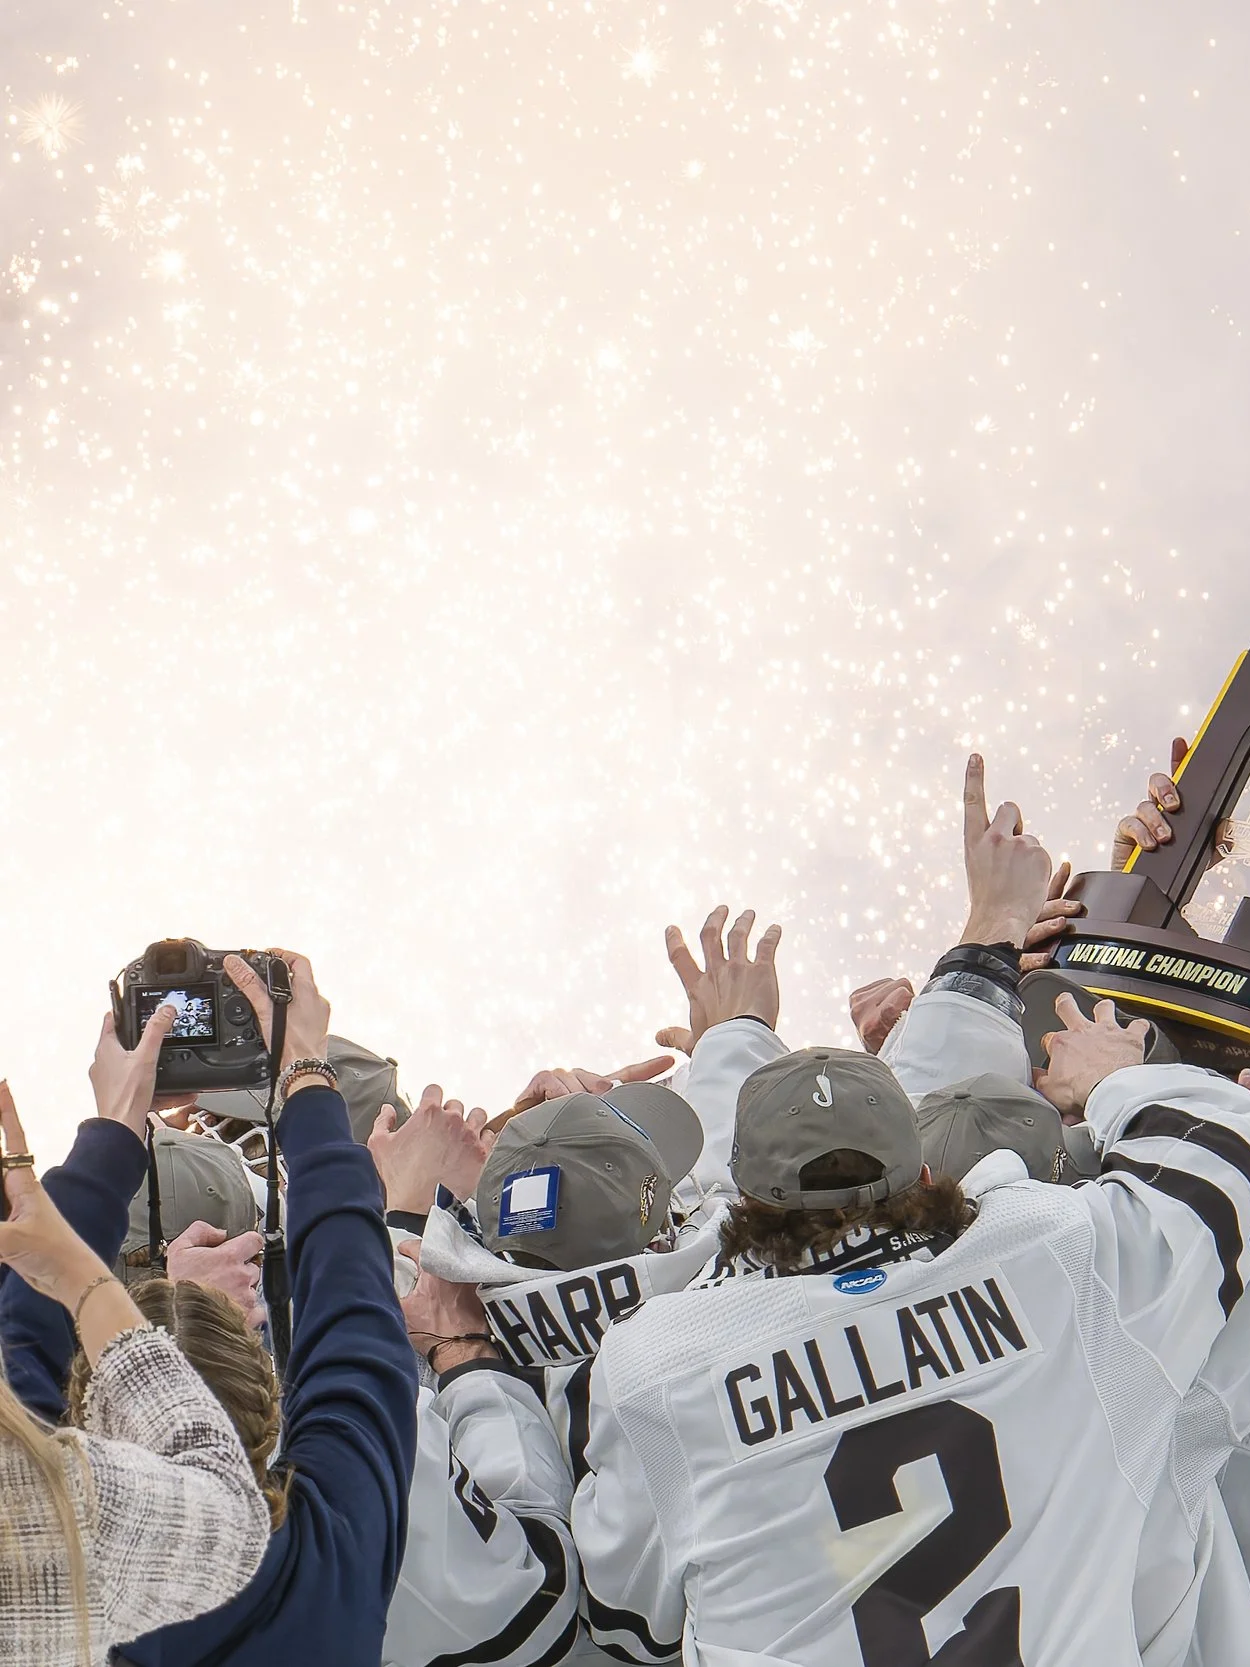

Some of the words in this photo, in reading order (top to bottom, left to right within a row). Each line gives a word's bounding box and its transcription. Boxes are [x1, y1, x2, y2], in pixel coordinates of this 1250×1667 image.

[1068, 943, 1146, 970] NATIONAL
[1146, 954, 1249, 995] CHAMPION
[841, 1273, 884, 1290] NCAA
[724, 1278, 1028, 1447] GALLATIN
[823, 1399, 1025, 1667] 2
